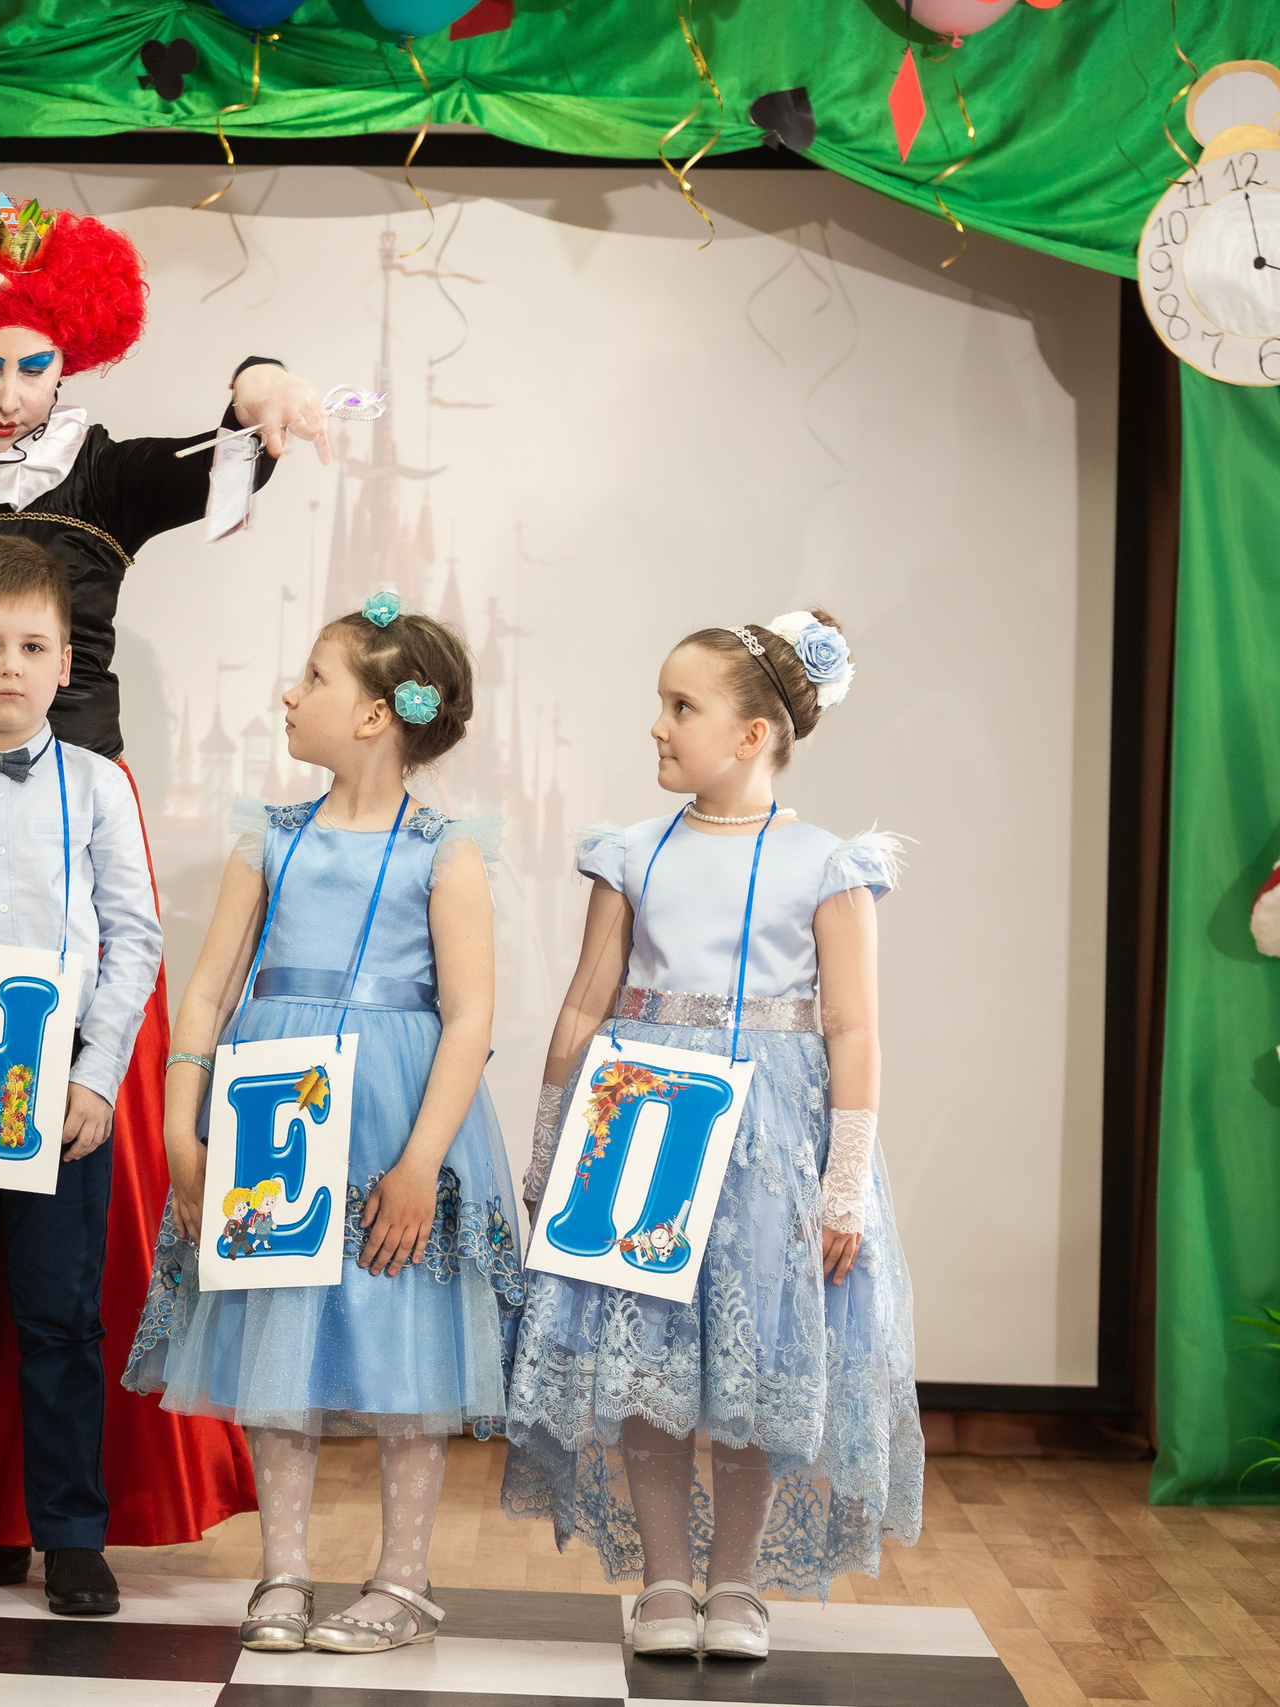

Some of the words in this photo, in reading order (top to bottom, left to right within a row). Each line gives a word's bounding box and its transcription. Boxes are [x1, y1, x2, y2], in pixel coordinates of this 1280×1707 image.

[1223, 152, 1268, 191] 12
[1177, 174, 1212, 209] 11
[1152, 210, 1189, 248] 10
[1148, 250, 1174, 292] 9
[1157, 293, 1191, 342] 8
[1201, 331, 1225, 369] 7
[546, 1061, 734, 1274] П
